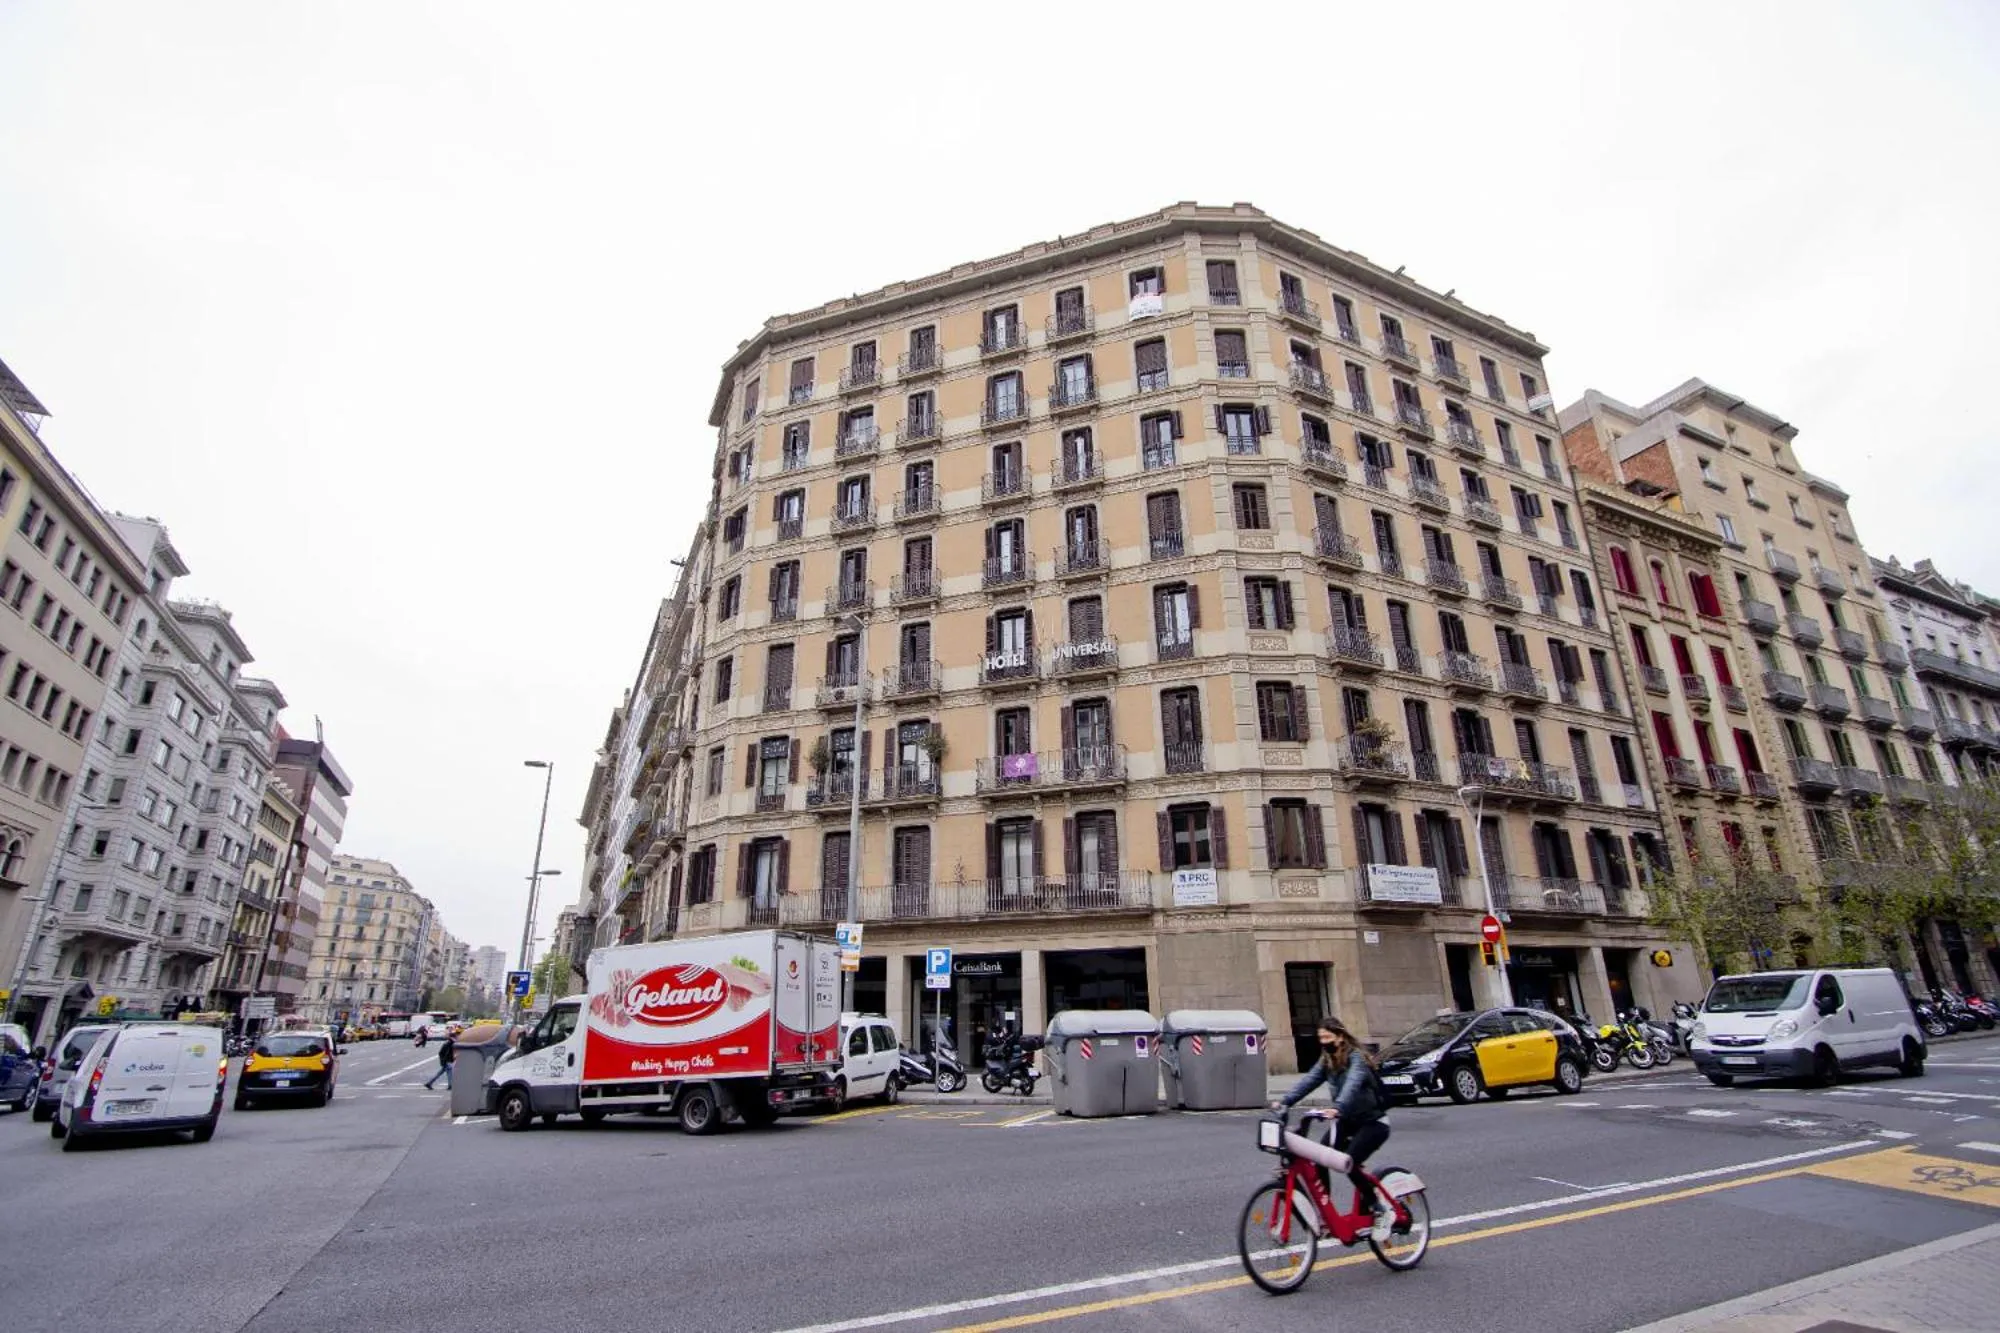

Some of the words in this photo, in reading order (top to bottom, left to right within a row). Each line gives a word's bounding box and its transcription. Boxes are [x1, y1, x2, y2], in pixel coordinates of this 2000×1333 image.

[986, 653, 1026, 670] HOTEL
[1053, 642, 1116, 660] UNIVERSAL
[1188, 872, 1209, 882] PRC
[931, 951, 947, 973] P
[953, 961, 1003, 973] CaixaBank
[625, 978, 724, 1016] Geland
[631, 1058, 663, 1074] Making
[664, 1057, 690, 1072] Happy
[691, 1054, 715, 1067] Chefs
